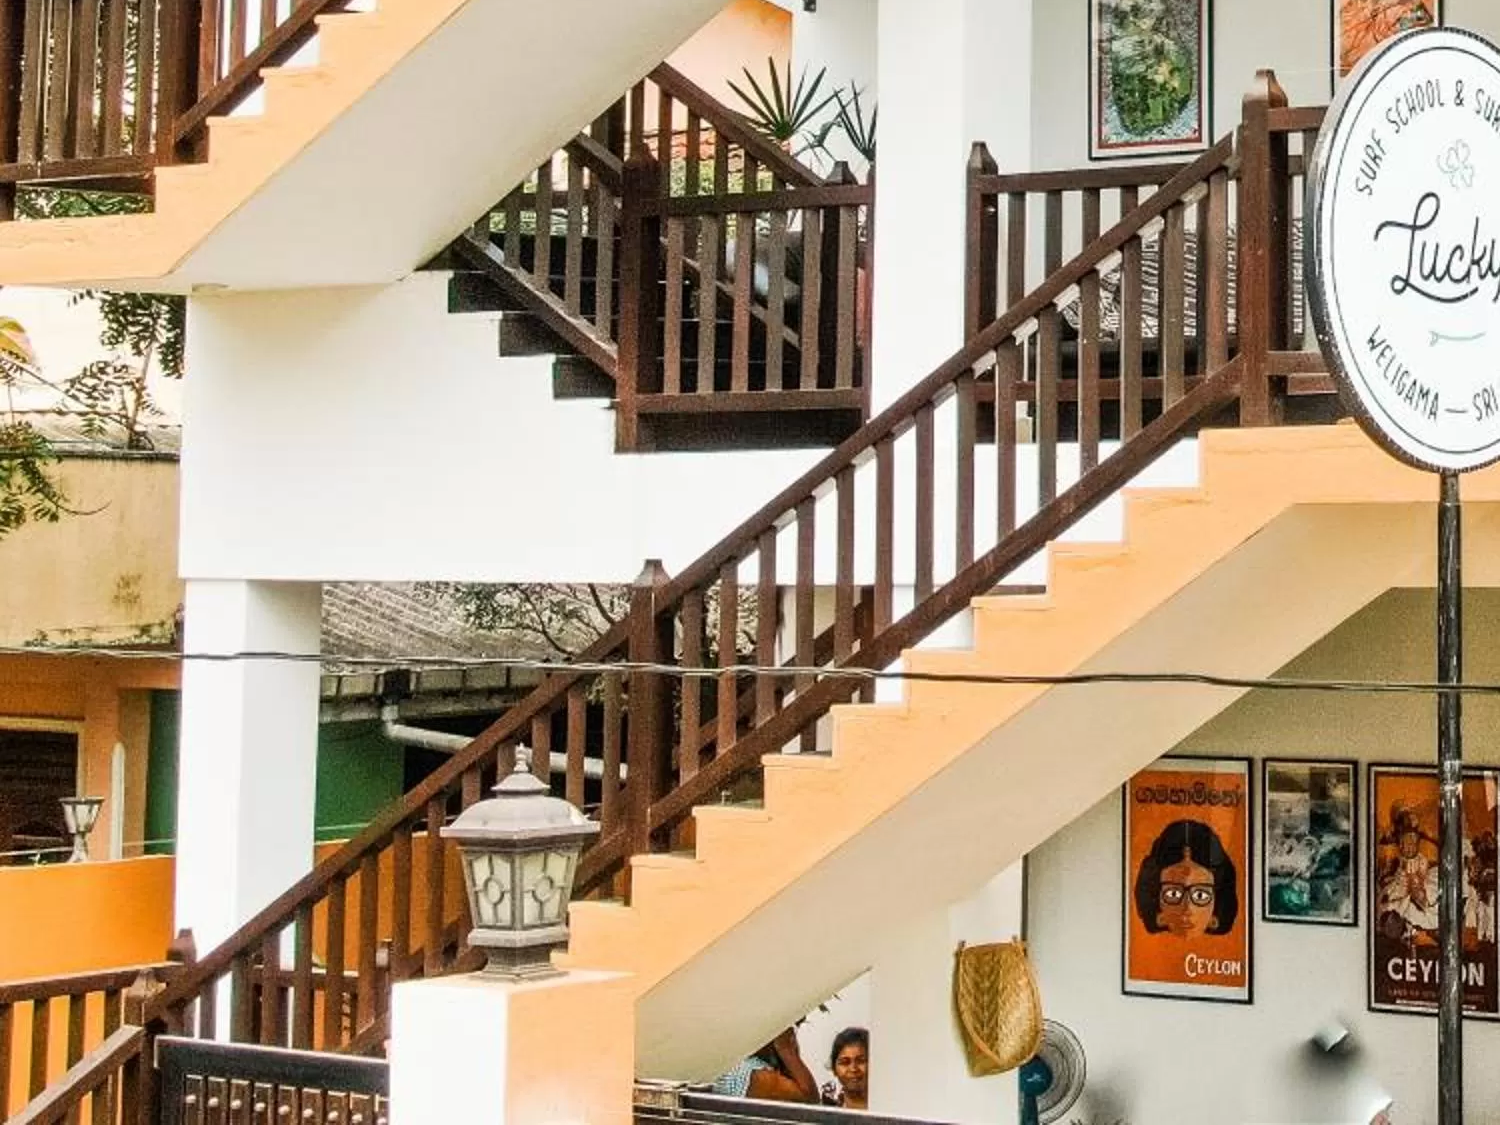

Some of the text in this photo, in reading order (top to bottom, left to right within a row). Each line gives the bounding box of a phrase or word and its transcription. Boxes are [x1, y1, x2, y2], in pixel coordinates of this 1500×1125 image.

[1355, 127, 1387, 196] SURF
[1385, 78, 1446, 134] SCHOOL
[1453, 78, 1465, 107] &
[1366, 324, 1440, 421] WELIGAMA
[1472, 384, 1499, 421] SRI
[1185, 952, 1242, 978] CEYLON
[1387, 956, 1485, 987] CEYN
